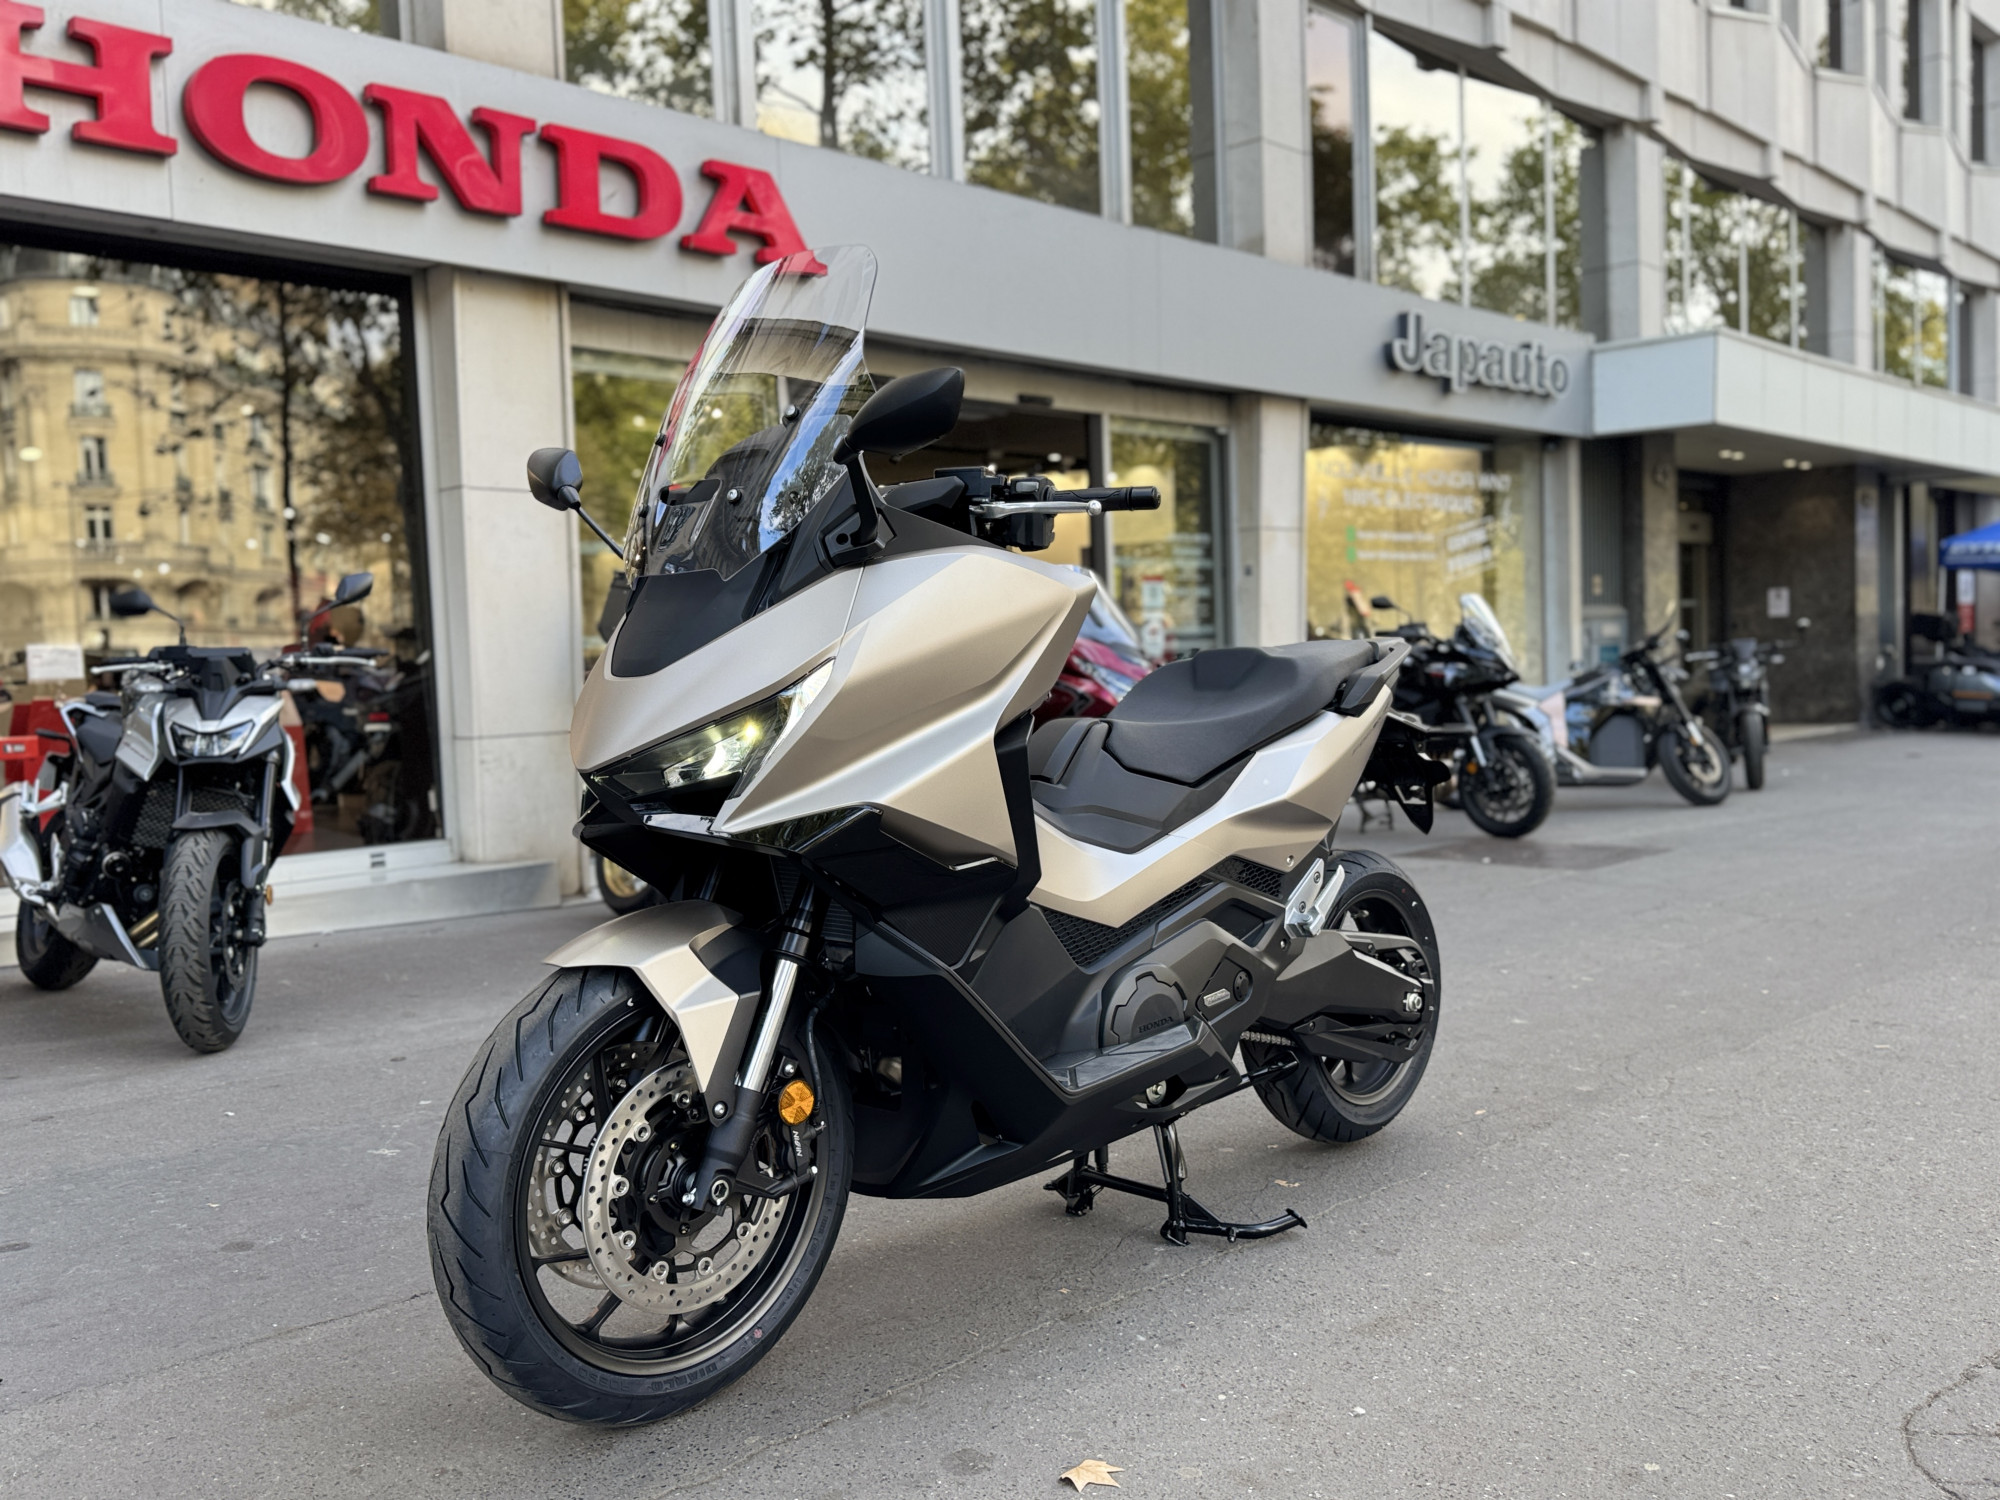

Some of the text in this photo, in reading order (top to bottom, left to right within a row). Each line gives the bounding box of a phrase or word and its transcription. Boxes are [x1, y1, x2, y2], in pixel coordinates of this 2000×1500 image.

[0, 3, 828, 277] HONDA
[1385, 309, 1571, 399] Japauto
[1138, 1016, 1174, 1033] HONDA
